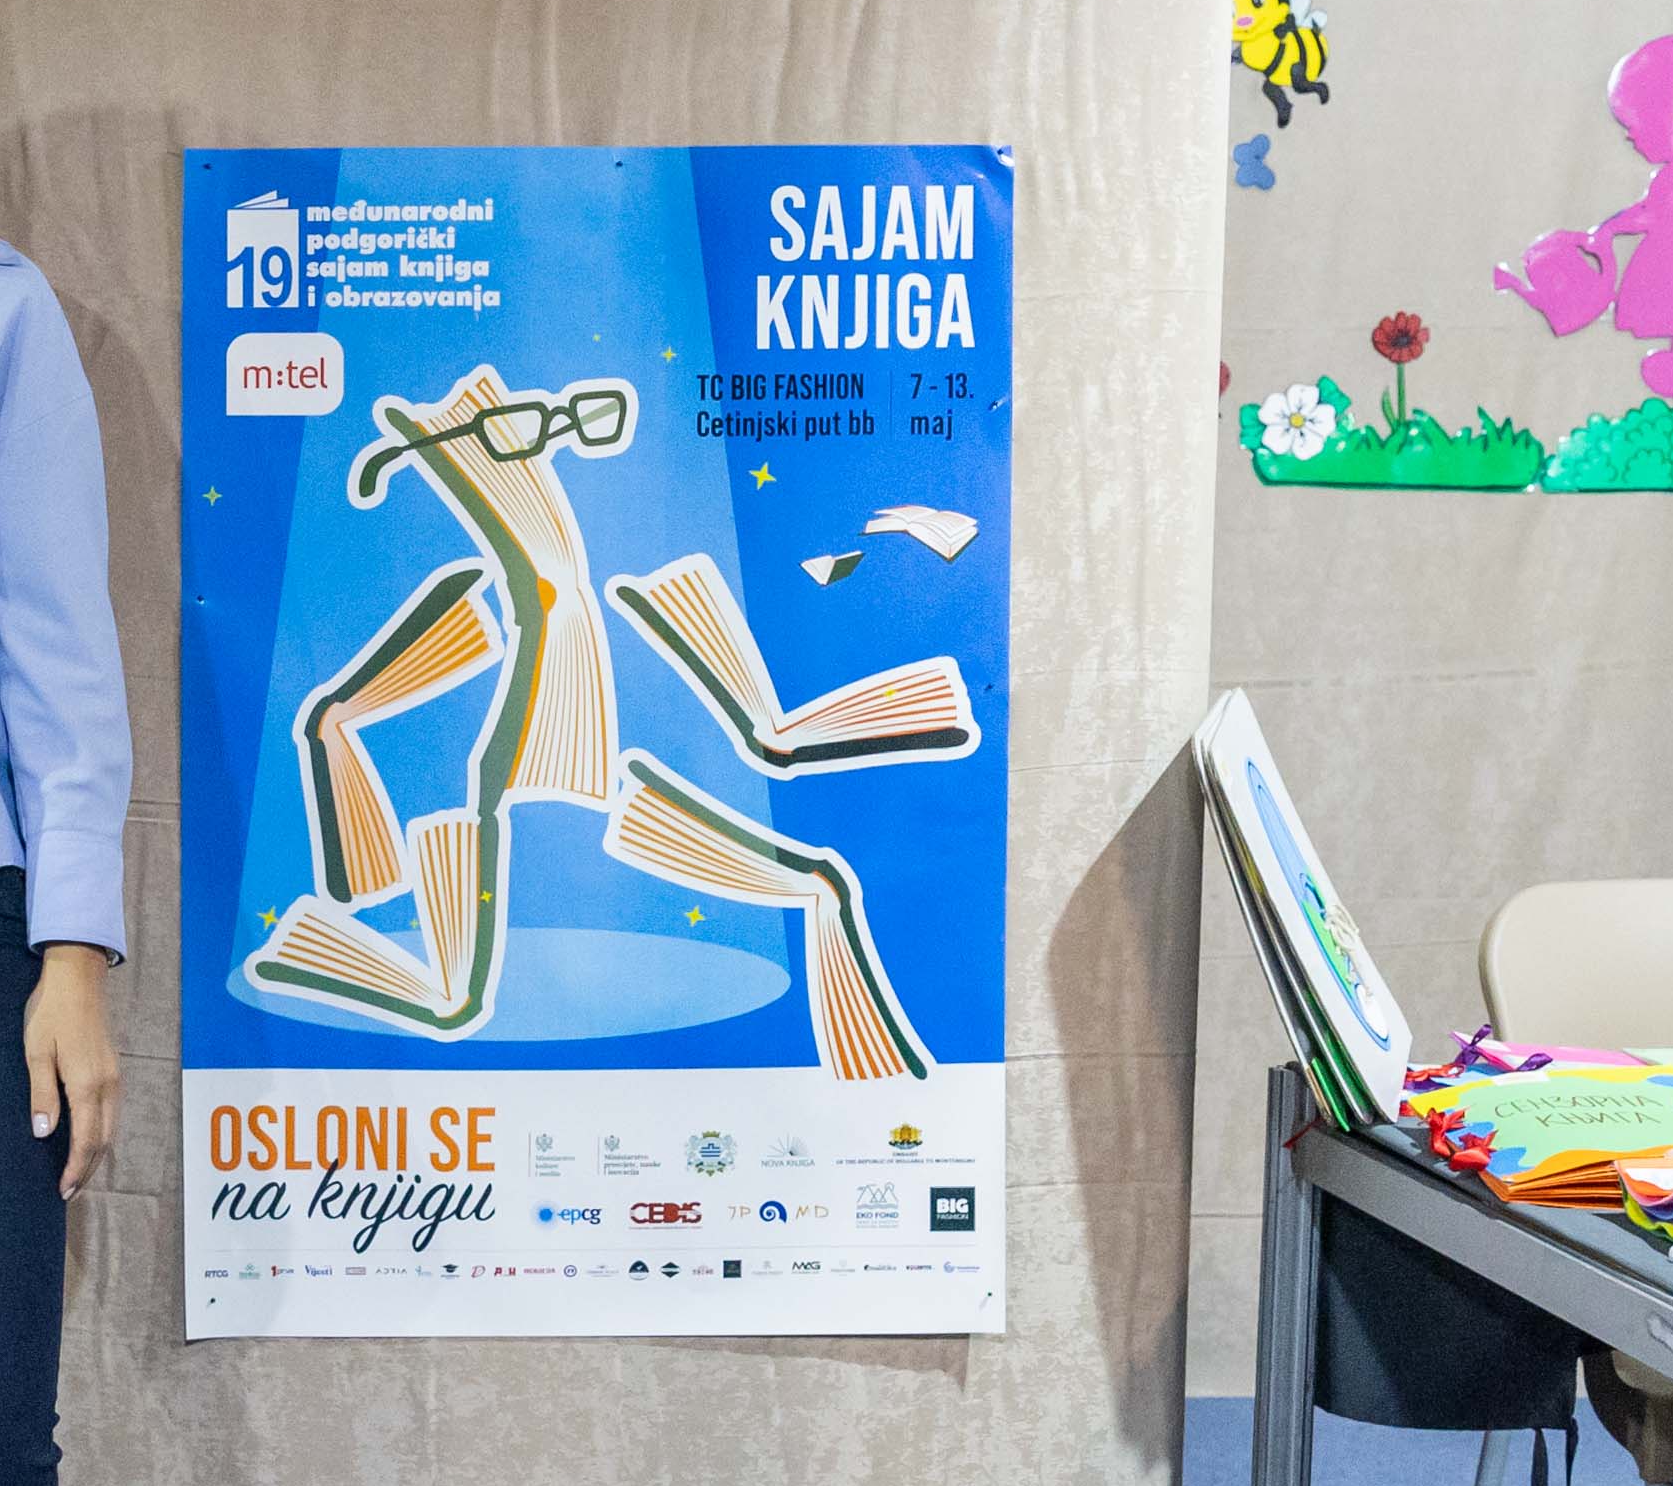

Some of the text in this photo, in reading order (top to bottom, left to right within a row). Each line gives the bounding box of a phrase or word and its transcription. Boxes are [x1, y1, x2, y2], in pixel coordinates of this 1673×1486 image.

[307, 199, 495, 225] međunarodni
[770, 182, 975, 262] SAJAM
[307, 225, 456, 255] podgorički
[228, 245, 293, 309] 19
[306, 254, 490, 283] sajam knjiga
[307, 284, 501, 313] i obrazovanja
[756, 272, 977, 350] KNJIGA
[243, 357, 328, 390] m:tel
[696, 373, 865, 402] TC BIG FASHION
[910, 373, 924, 399] 7
[945, 372, 975, 400] 13.
[696, 409, 876, 444] Cetinjski put bb
[910, 412, 954, 442] maj
[1494, 1094, 1665, 1120] СЕНЗОРНА
[1535, 1111, 1662, 1129] КЊИГА
[209, 1105, 497, 1172] OSLONI SE
[761, 1159, 785, 1168] NOVA
[211, 1159, 497, 1255] na knjigu
[562, 1207, 602, 1225] epcg
[856, 1211, 899, 1219] EKO FOND
[936, 1197, 969, 1214] BIG
[204, 1270, 229, 1278] RTCG
